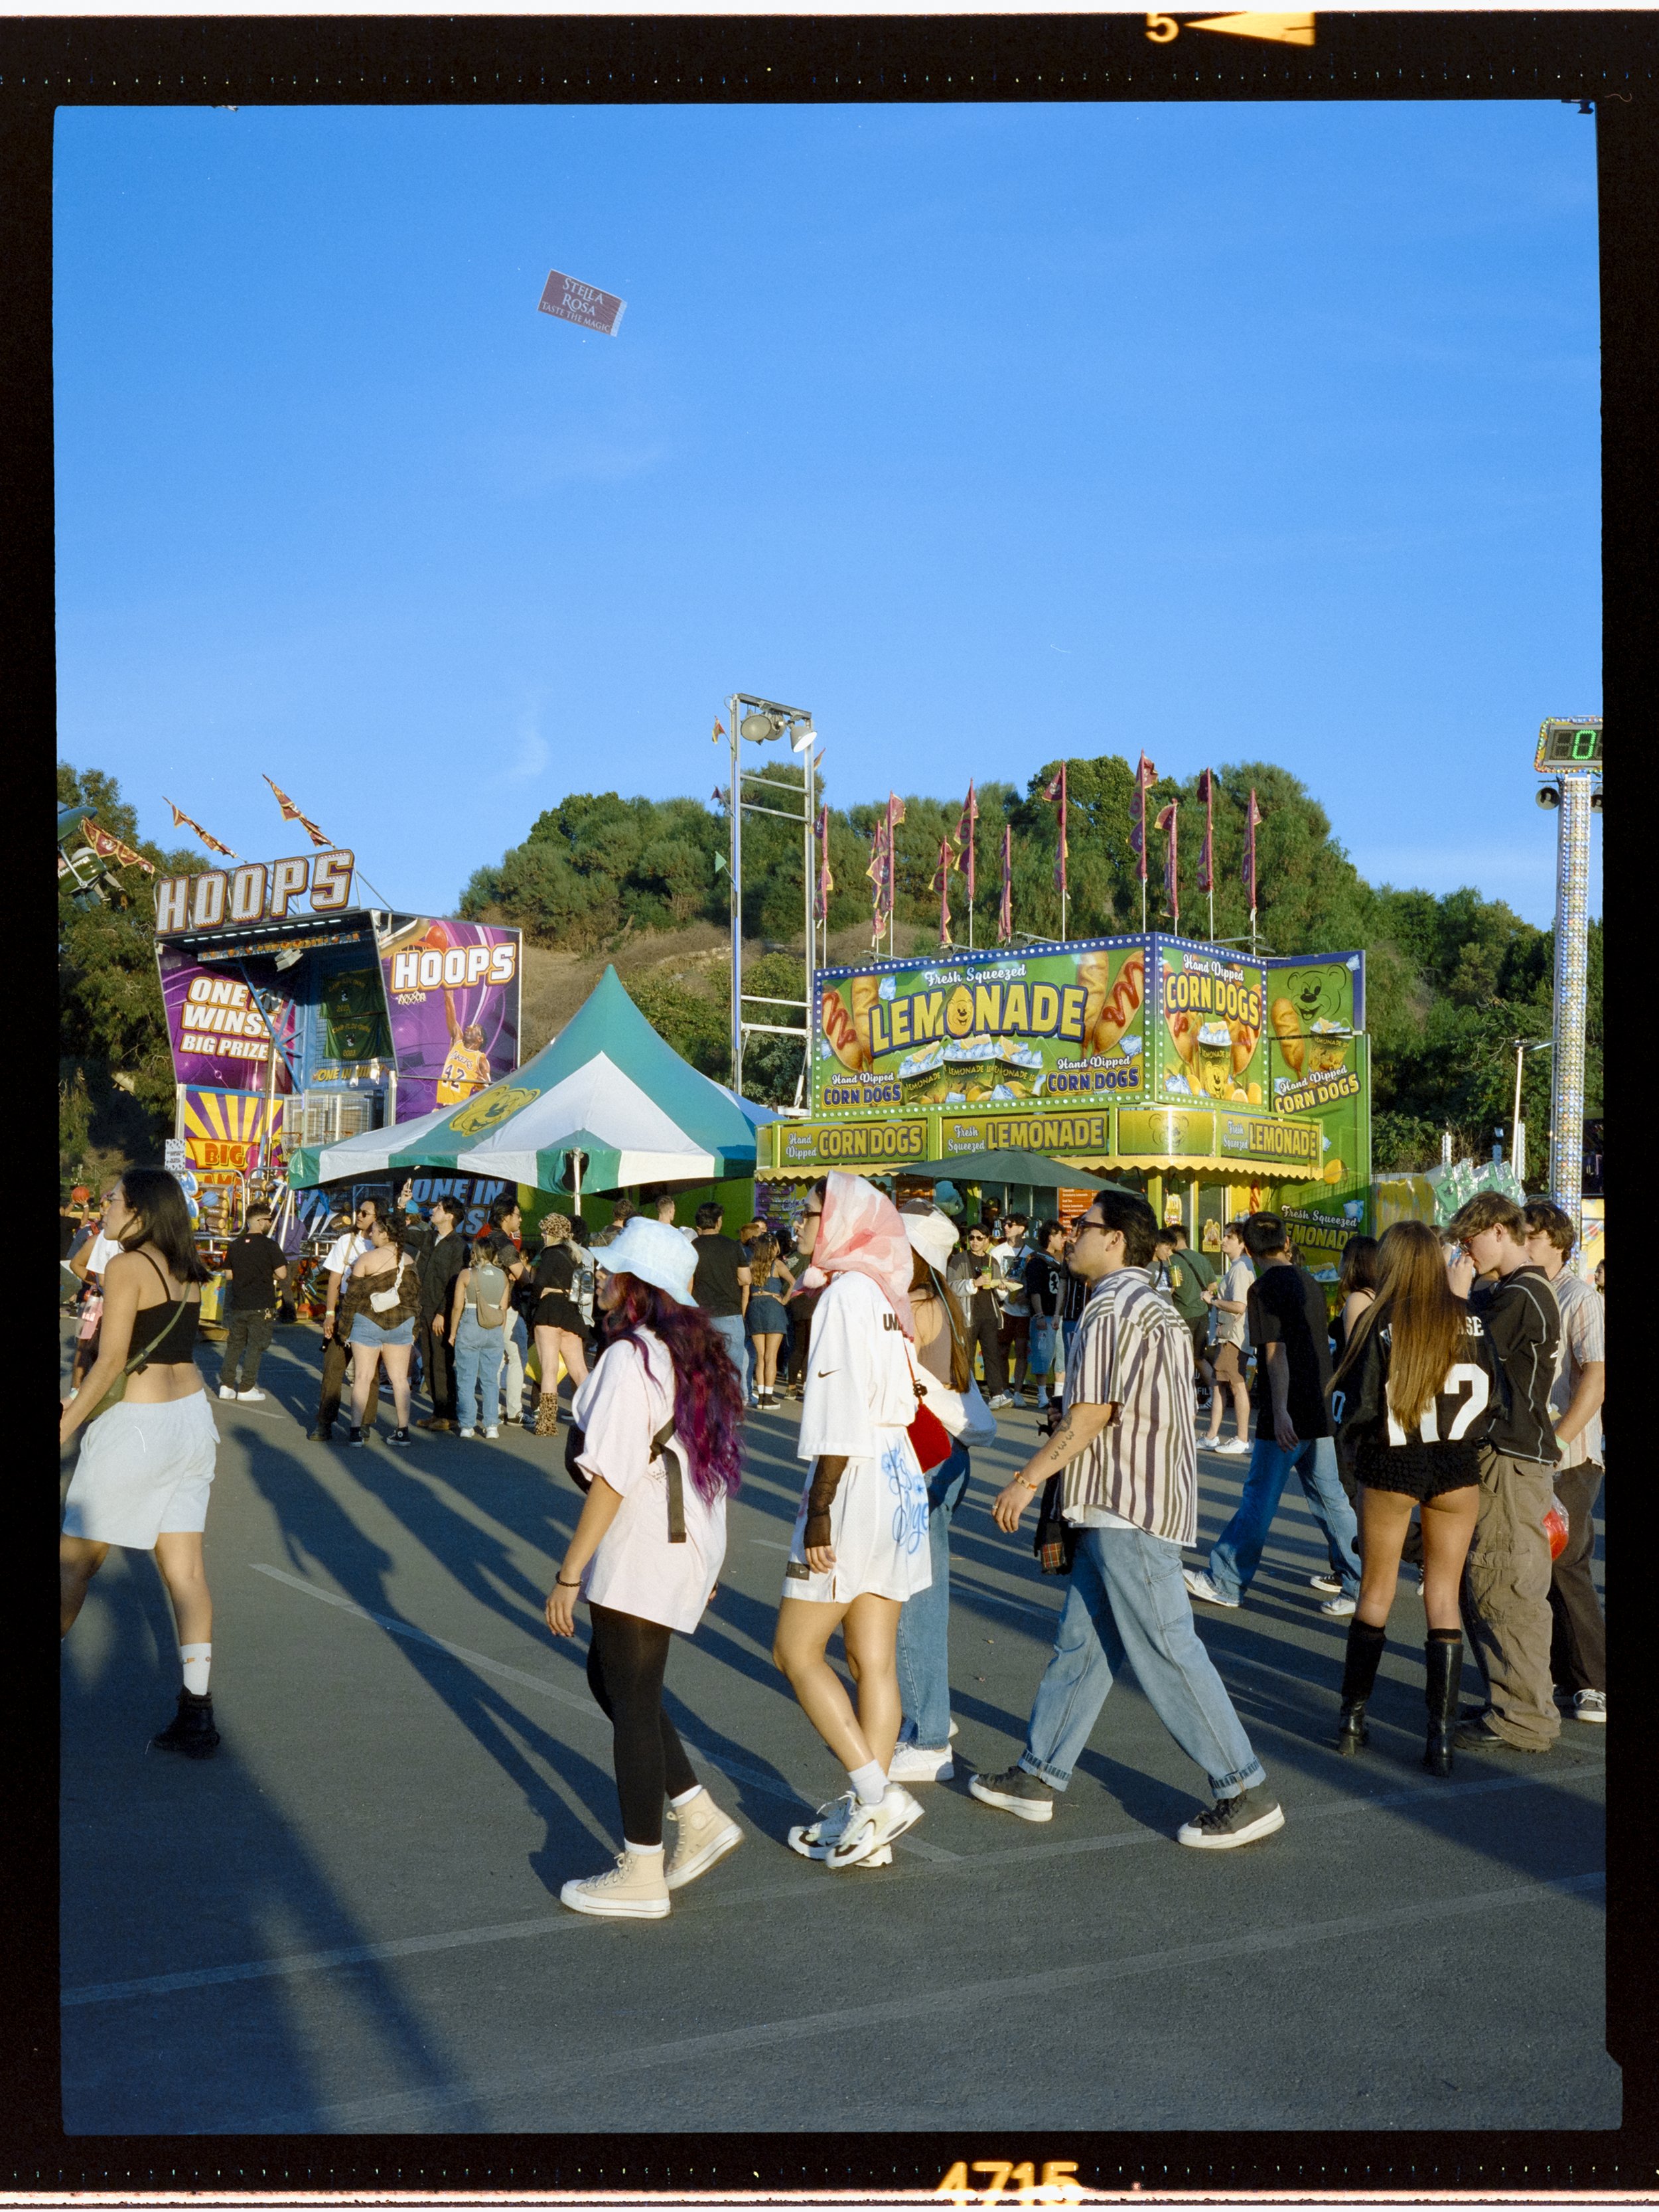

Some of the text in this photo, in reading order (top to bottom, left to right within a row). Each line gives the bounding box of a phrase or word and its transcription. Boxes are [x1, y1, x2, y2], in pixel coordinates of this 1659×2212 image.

[563, 278, 603, 305] STELLA
[541, 301, 611, 332] TASTE THE MAGIC
[562, 293, 596, 317] ROSA
[1572, 729, 1597, 760] 0
[155, 849, 355, 935] HOOPS
[392, 943, 516, 993] HOOPS
[924, 964, 1027, 986] Fresh Squeezed
[1184, 954, 1245, 983] Hand Dipped
[188, 977, 250, 1009] ONE
[1165, 972, 1262, 1030] CORN DOGS
[182, 1003, 277, 1039] WINS!
[181, 1034, 217, 1055] BIG
[949, 1065, 983, 1075] LEMONADE
[1057, 1056, 1130, 1069] Hand Dipped
[317, 1069, 339, 1081] ONE
[341, 1069, 352, 1078] IN
[443, 1065, 465, 1090] 42
[832, 1072, 894, 1084] Hand Dipped
[906, 1072, 941, 1090] LEMONADE
[1048, 1067, 1139, 1092] CORN DOGS
[1279, 1065, 1347, 1094] Hand Dipped
[824, 1083, 902, 1106] CORN DOGS
[1274, 1073, 1360, 1114] CORN DOGS
[788, 1133, 812, 1145] Hand
[954, 1125, 978, 1138] Fresh
[986, 1117, 1104, 1150] LEMONADE
[1228, 1120, 1244, 1134] Fresh
[786, 1146, 817, 1159] Dipped
[818, 1126, 923, 1159] CORN DOGS
[948, 1140, 985, 1153] Squeezed
[1223, 1134, 1248, 1151] Squeezed
[1249, 1122, 1317, 1159] LEMONADE
[205, 1143, 243, 1165] BIG
[412, 1179, 469, 1203] ONE
[1281, 1206, 1357, 1227] Fresh Squeezed
